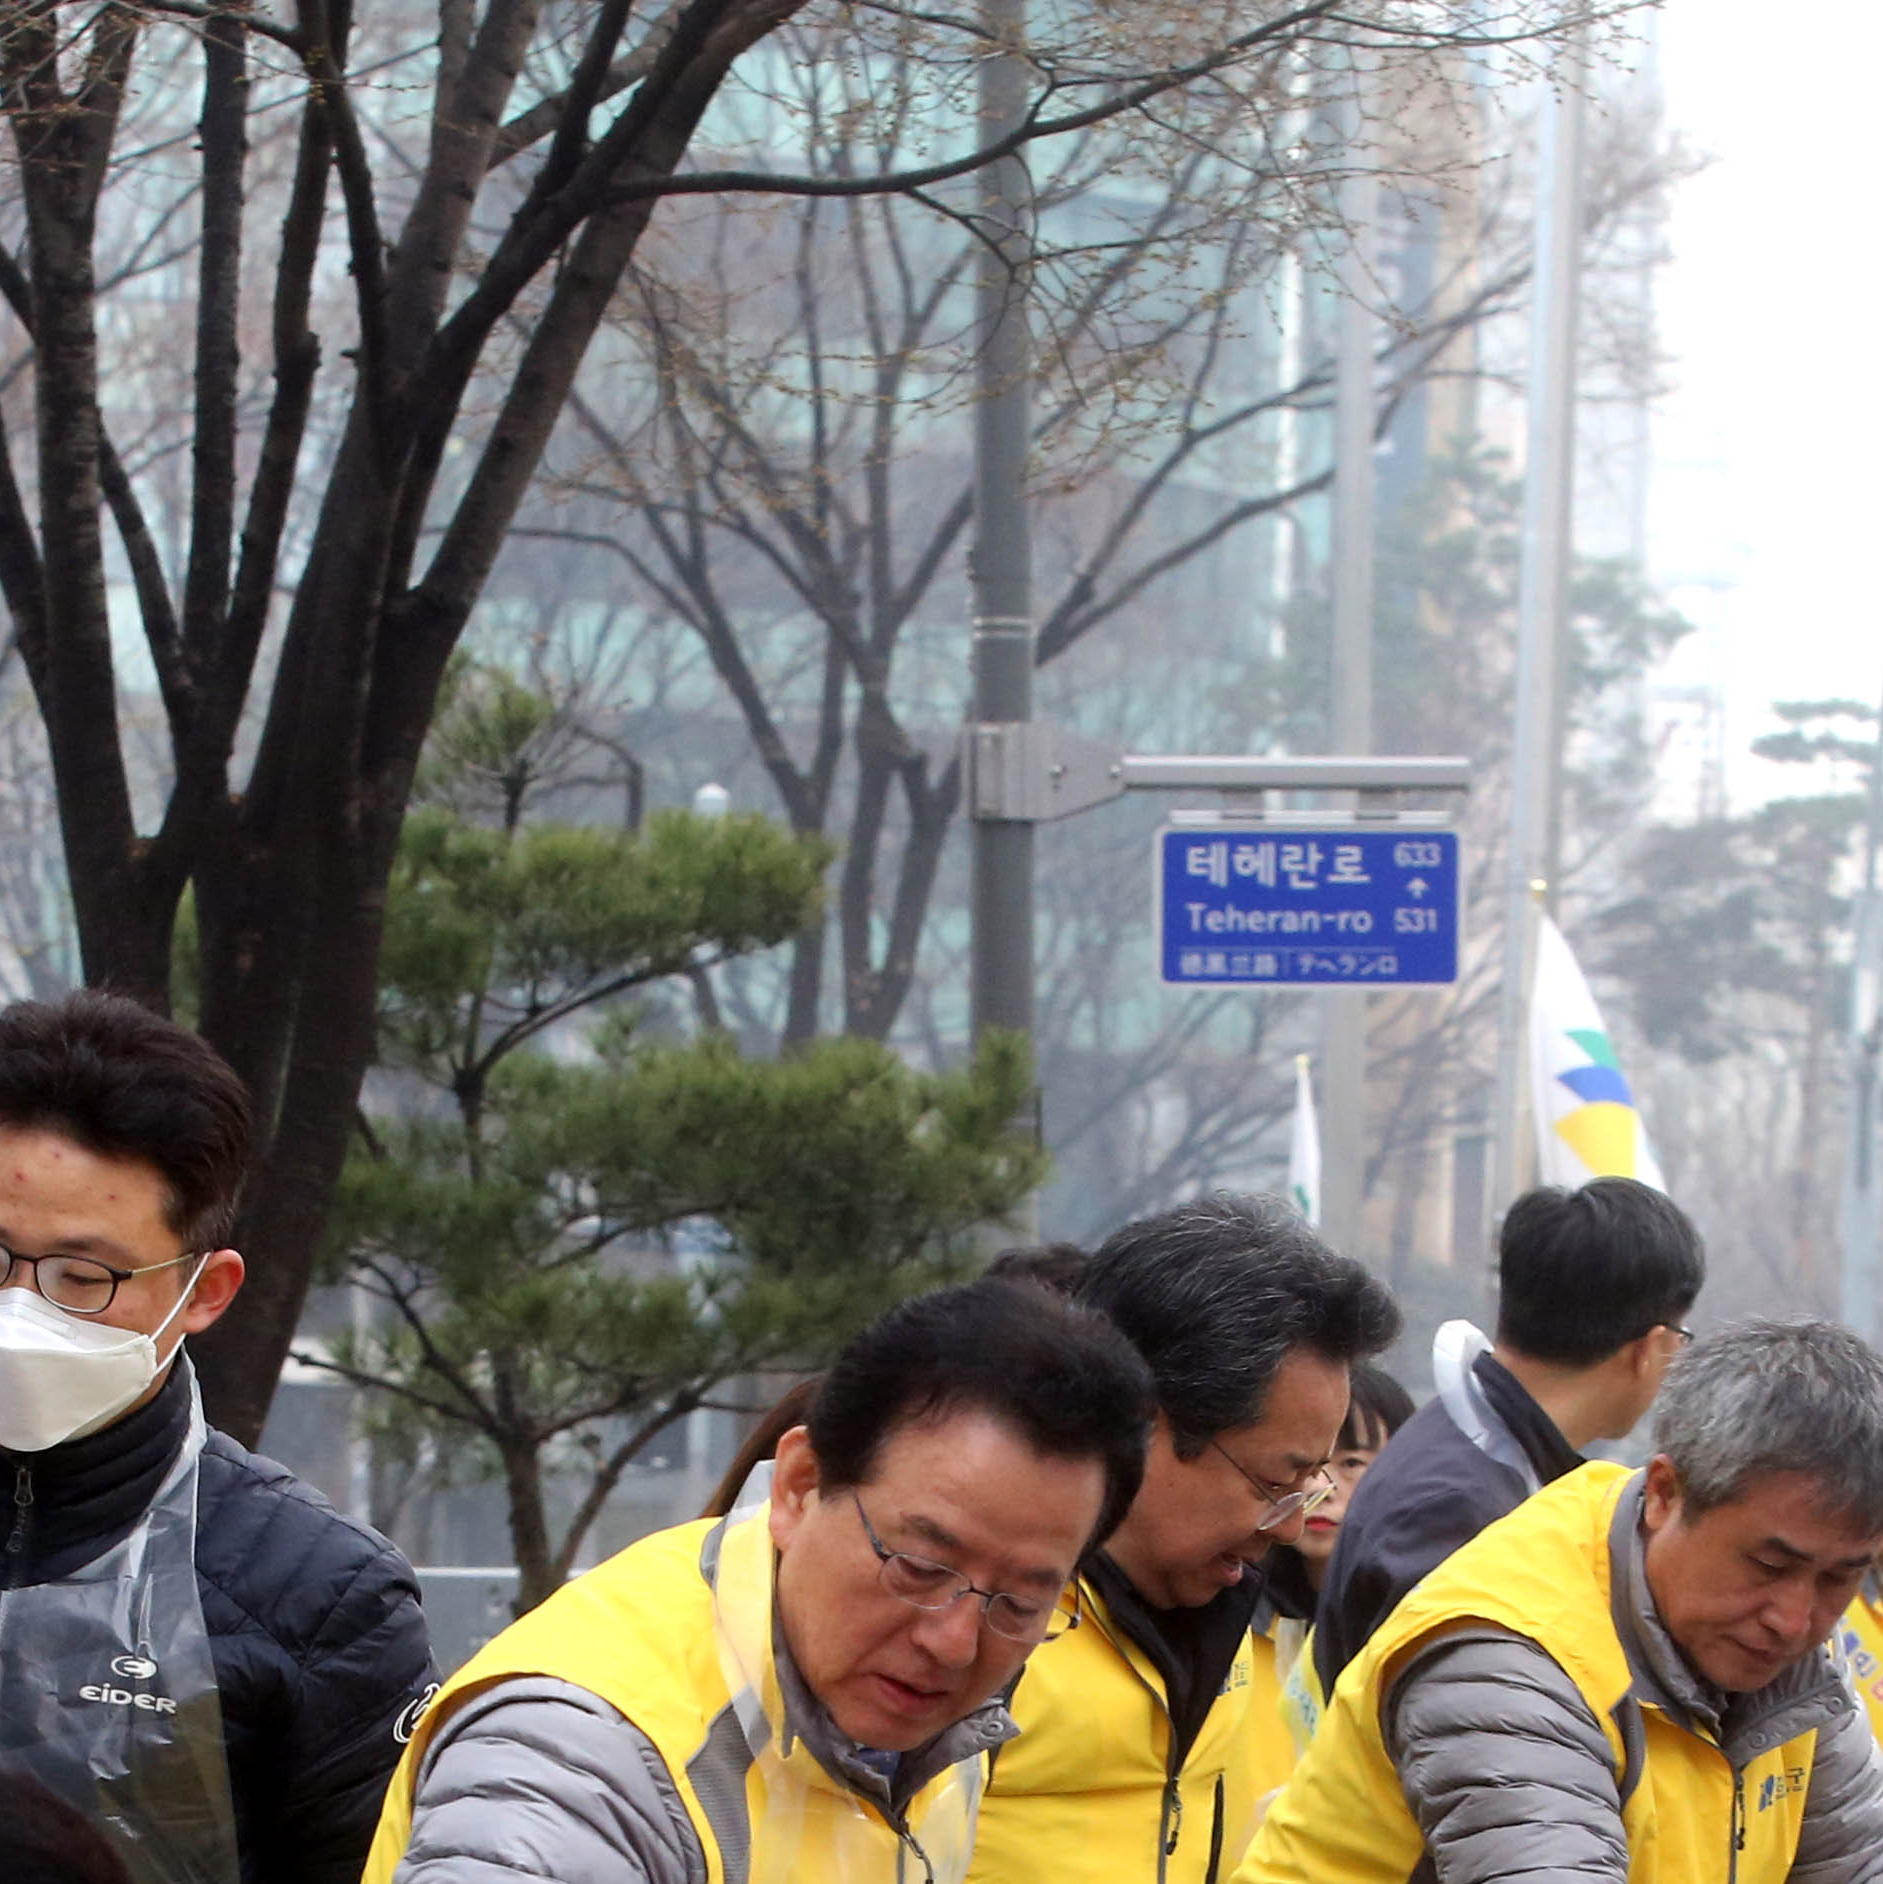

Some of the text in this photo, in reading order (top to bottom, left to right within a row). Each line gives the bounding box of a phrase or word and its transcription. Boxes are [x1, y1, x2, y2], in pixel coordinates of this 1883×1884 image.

[1186, 842, 1371, 889] 테헤란로
[1394, 842, 1441, 868] 633
[1185, 903, 1373, 933] Teheran-ro
[1394, 908, 1438, 933] 531
